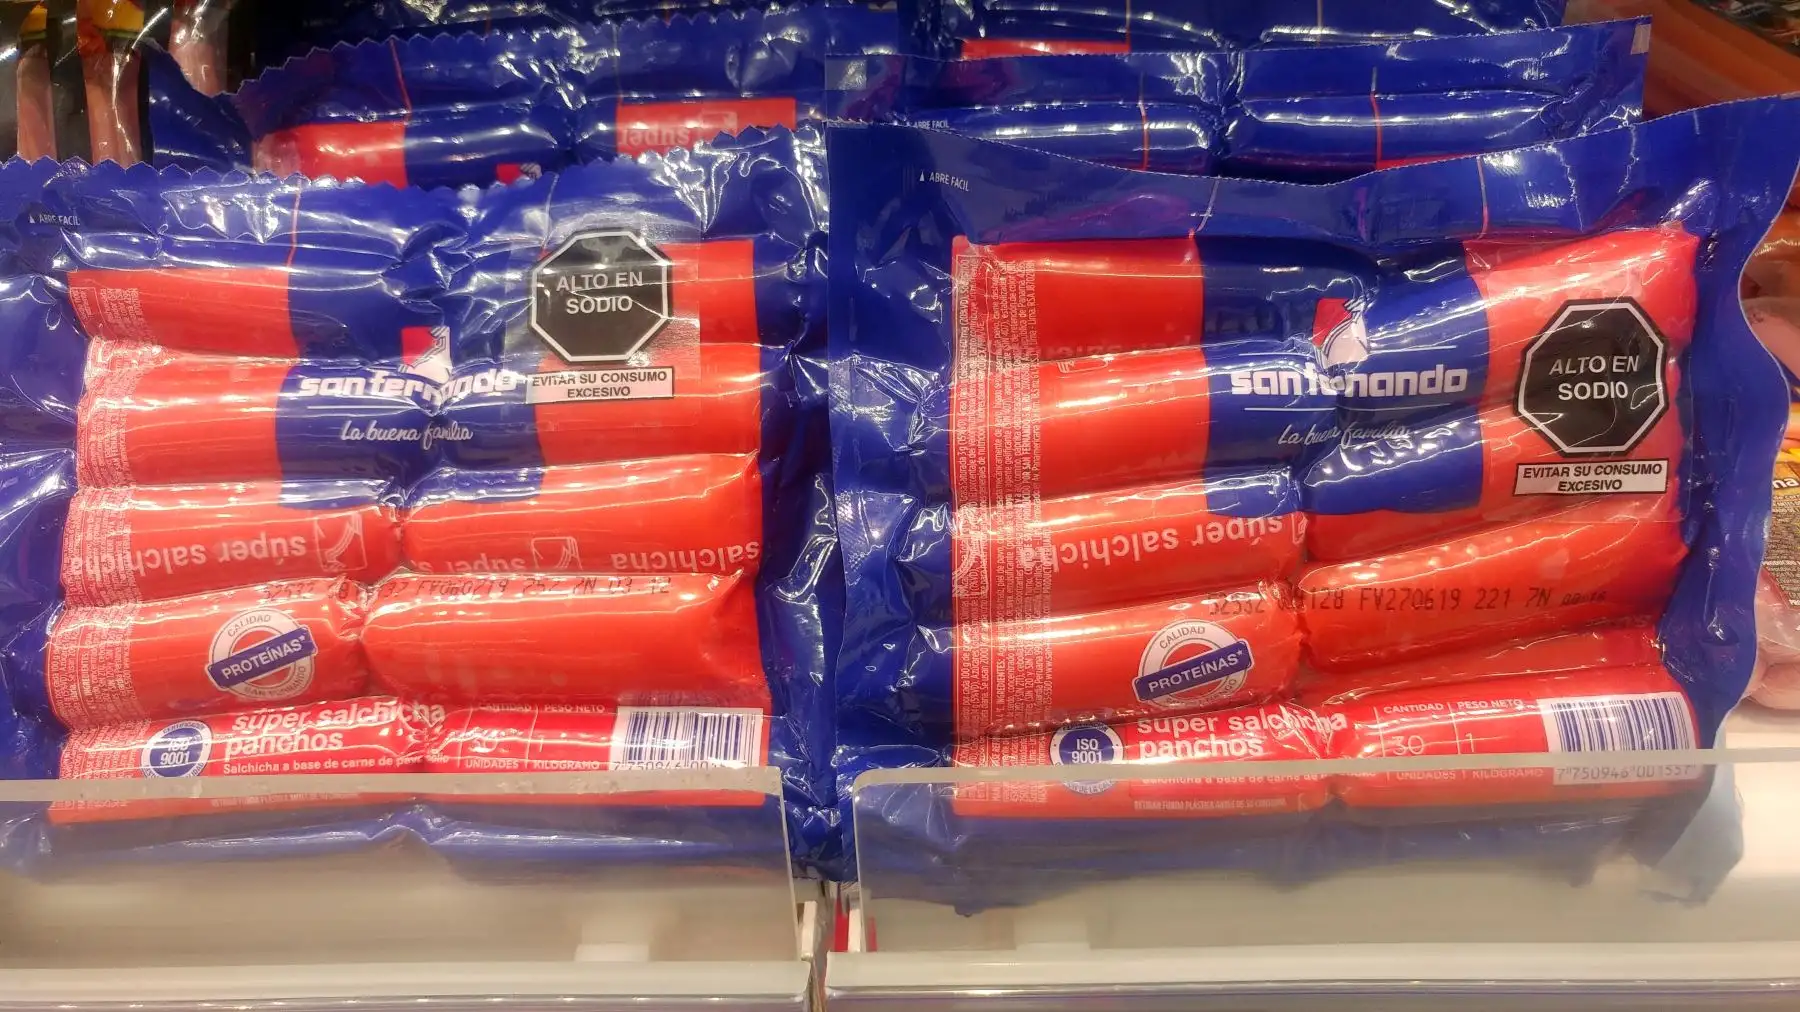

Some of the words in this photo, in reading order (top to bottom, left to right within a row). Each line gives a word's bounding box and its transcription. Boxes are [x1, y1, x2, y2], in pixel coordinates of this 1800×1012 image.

[929, 171, 950, 185] ABRE
[950, 176, 970, 191] FACIL
[57, 215, 81, 226] FACIL
[555, 272, 609, 292] ALTO
[616, 271, 643, 288] EN
[566, 295, 633, 315] SODIO
[1549, 355, 1606, 376] ALTO
[1612, 355, 1640, 373] EN
[532, 373, 576, 387] EVITAR
[579, 373, 597, 384] SU
[600, 371, 667, 384] CONSUMO
[567, 386, 631, 399] EXCESIVO
[1558, 381, 1629, 401] SODIO
[341, 419, 365, 441] La
[366, 423, 422, 443] buena
[1022, 420, 1030, 454] FERNANDO
[1278, 423, 1303, 446] La
[1032, 425, 1041, 470] Panamericana
[1523, 466, 1570, 479] EVITAR
[1573, 466, 1591, 477] SU
[1594, 463, 1662, 476] CONSUMO
[1557, 479, 1623, 492] EXCESIVO
[217, 535, 306, 566] súper
[1474, 587, 1510, 609] 221
[1526, 587, 1551, 608] 7N
[227, 614, 272, 638] CALIDAD
[1159, 626, 1206, 649] CALIDAD
[980, 648, 988, 664] 2000
[961, 668, 969, 679] 100
[996, 659, 1005, 704] INGREDIENTES:
[478, 702, 532, 713] CANTIDAD
[543, 703, 574, 713] PESO
[576, 703, 606, 713] NETO
[1383, 702, 1445, 714] CANTIDAD
[1457, 699, 1489, 711] PESO
[1491, 698, 1523, 710] NETO
[222, 731, 344, 762] panchos
[1076, 738, 1099, 751] ISO
[1138, 733, 1265, 760] panchos
[1391, 734, 1426, 756] 30
[160, 751, 191, 766] 9001
[223, 762, 280, 775] Salchicha
[282, 762, 290, 771] a
[293, 759, 321, 771] base
[324, 758, 339, 769] de
[341, 758, 375, 769] carne
[377, 756, 393, 767] de
[465, 758, 520, 770] UNIDADES
[533, 760, 601, 771] KILOGRAMO
[1071, 750, 1103, 764] 9001
